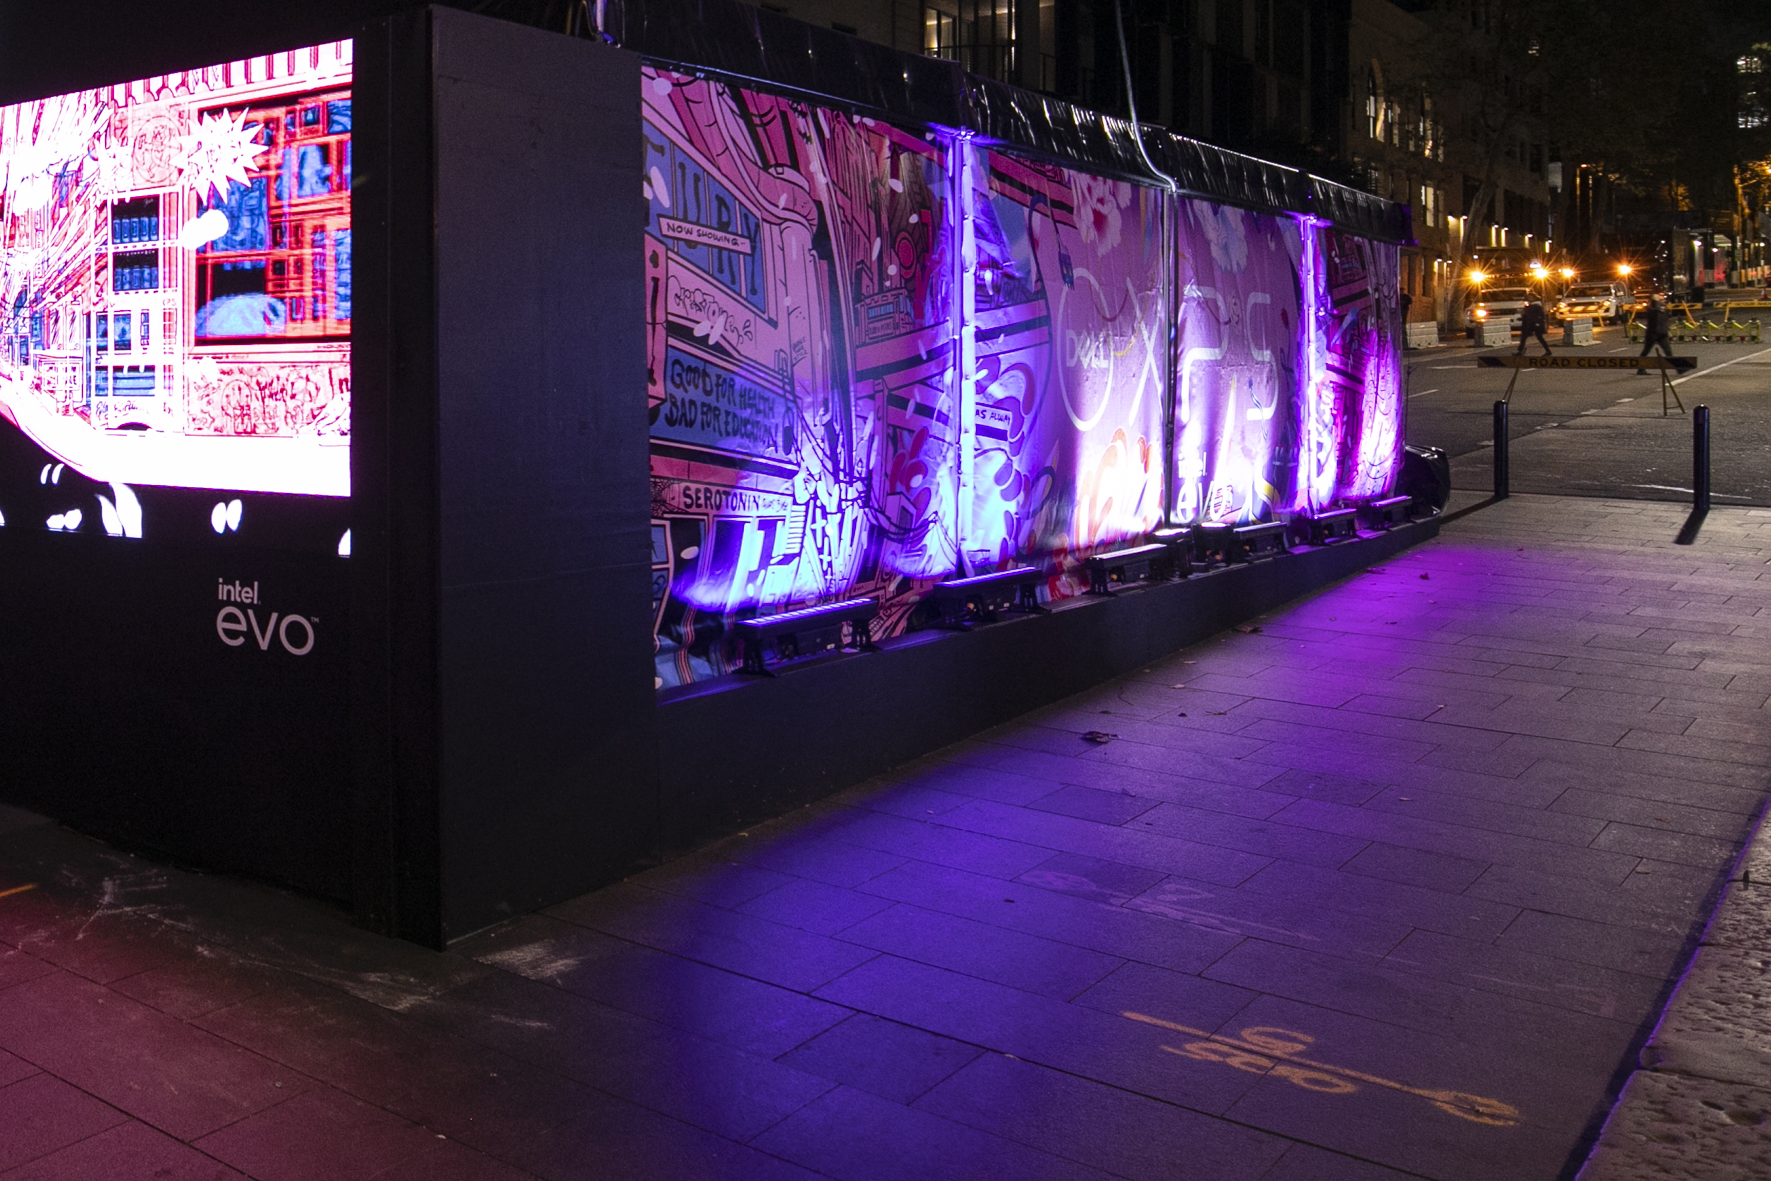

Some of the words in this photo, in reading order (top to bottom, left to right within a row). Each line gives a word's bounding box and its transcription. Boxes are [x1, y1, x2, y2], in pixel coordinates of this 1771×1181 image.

[666, 221, 693, 237] NOW
[1529, 358, 1571, 368] ROAD
[1578, 358, 1640, 368] CLOSED
[670, 359, 713, 397] GOOD
[715, 373, 737, 407] FOR
[739, 384, 777, 418] HEALTH
[664, 392, 698, 429] BAD
[700, 400, 723, 438] FOR
[682, 485, 760, 512] SEROTONIN
[216, 605, 315, 656] evo
